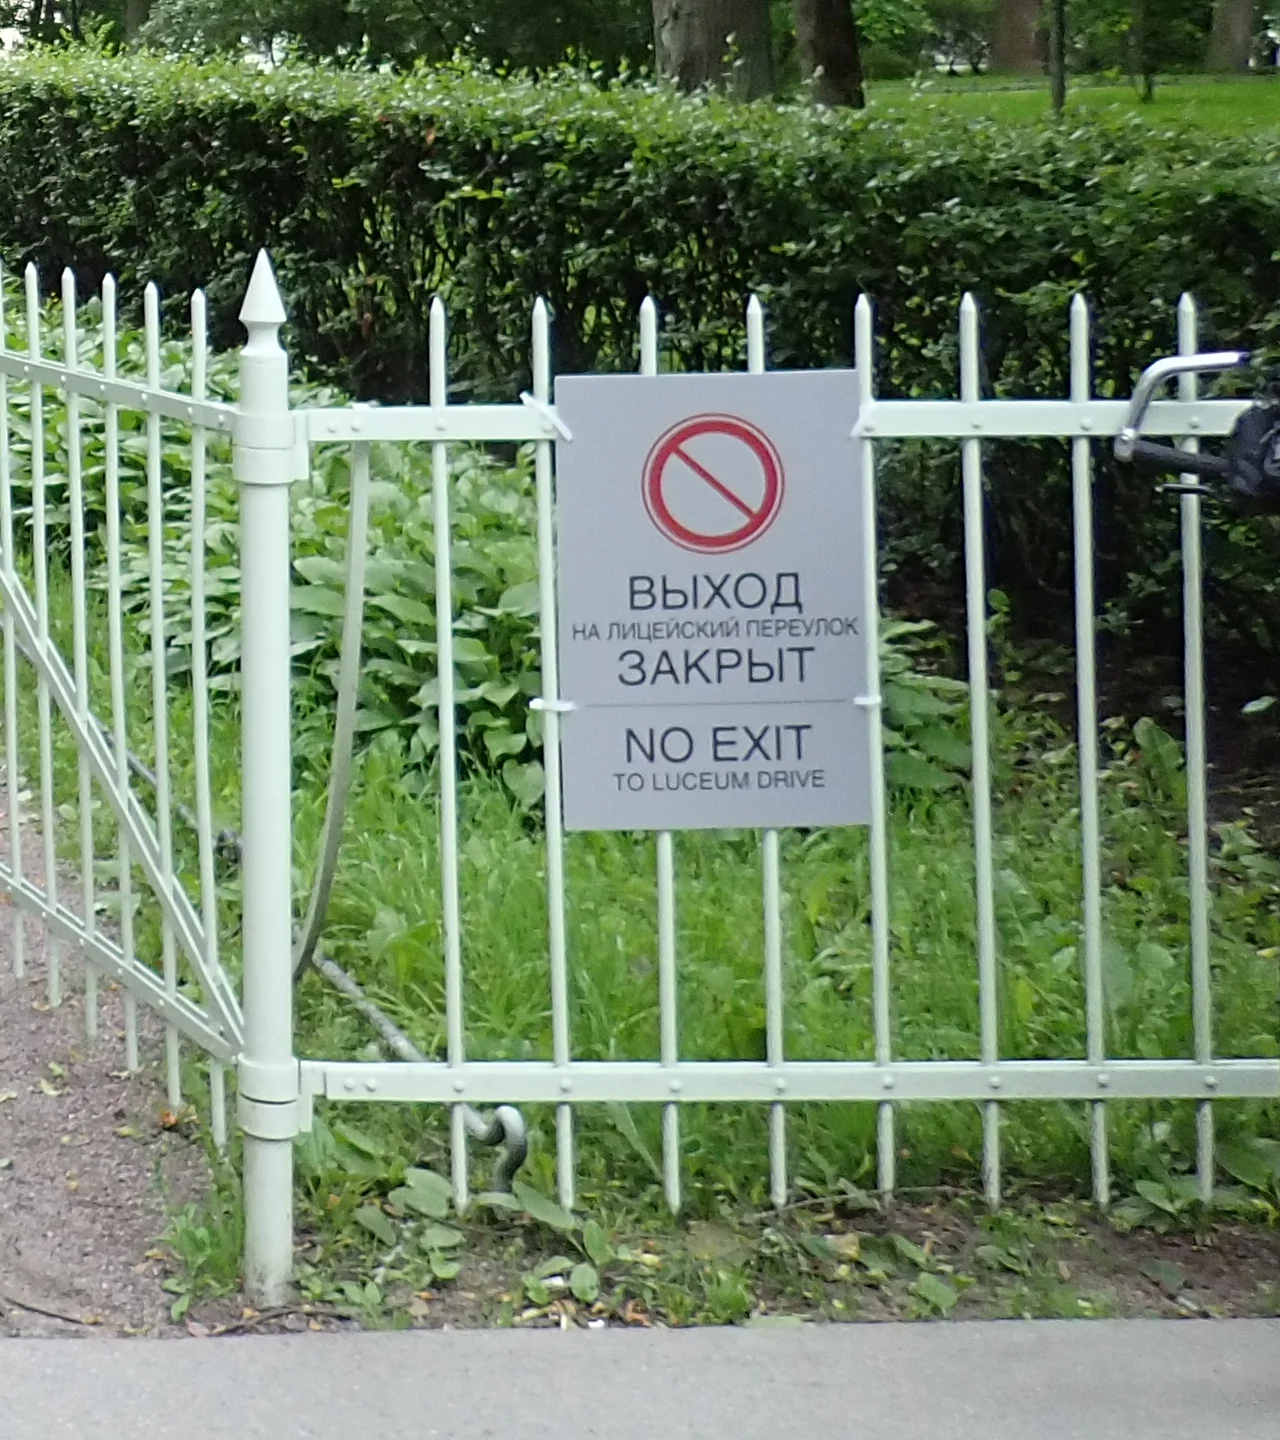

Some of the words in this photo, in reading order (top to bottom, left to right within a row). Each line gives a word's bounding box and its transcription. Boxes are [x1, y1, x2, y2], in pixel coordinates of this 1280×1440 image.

[628, 572, 803, 615] ВЫХОД
[572, 623, 600, 641] НА
[607, 617, 740, 643] ЛИЦЕЙСКИЙ
[746, 616, 859, 637] ПЕРЕУЛОК
[618, 646, 815, 686] ЗАКРЫТ
[626, 727, 694, 763] NO
[712, 724, 812, 762] EXIT
[613, 773, 644, 791] TO
[652, 771, 750, 791] LUCEUM
[757, 769, 825, 789] DRIVE
